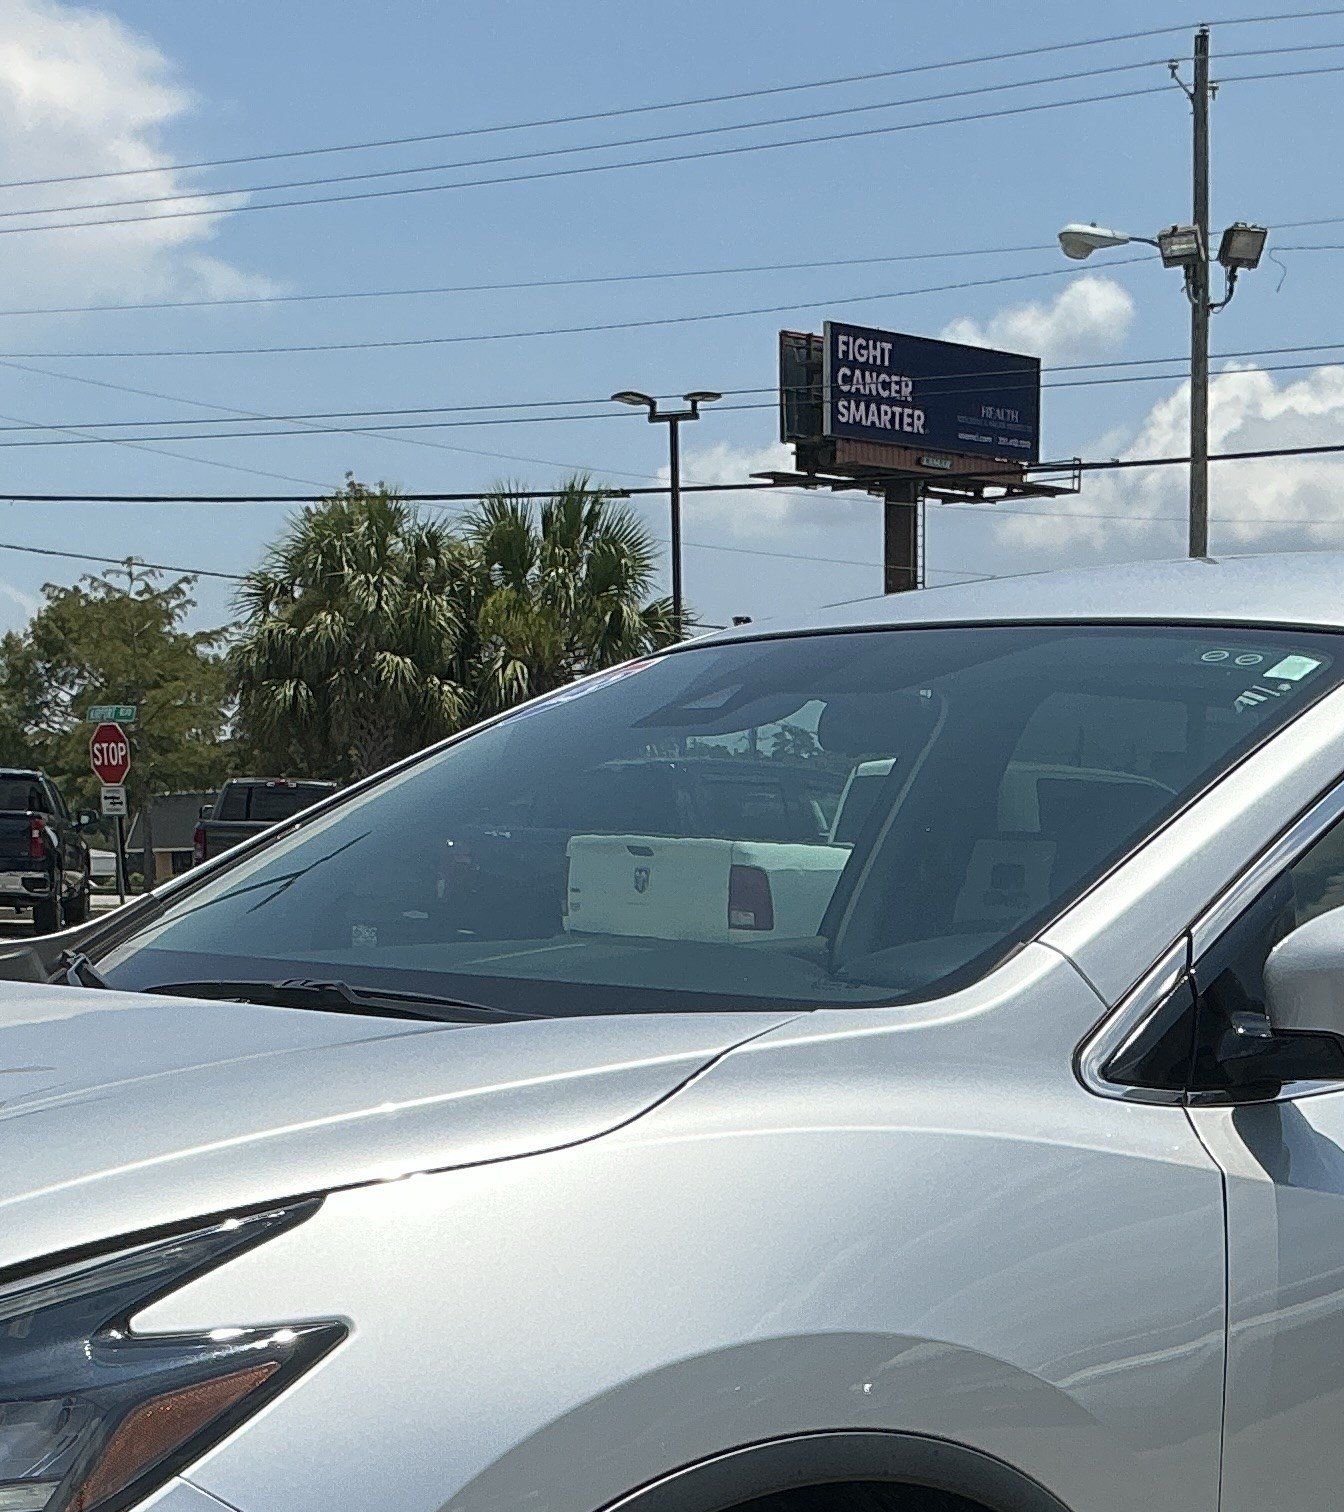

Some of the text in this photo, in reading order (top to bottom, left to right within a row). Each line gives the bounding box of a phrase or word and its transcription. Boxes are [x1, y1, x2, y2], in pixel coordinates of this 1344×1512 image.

[837, 333, 893, 367] FIGHT
[837, 366, 913, 402] CANCER
[981, 405, 1019, 423] HEALTH
[93, 742, 127, 766] STOP
